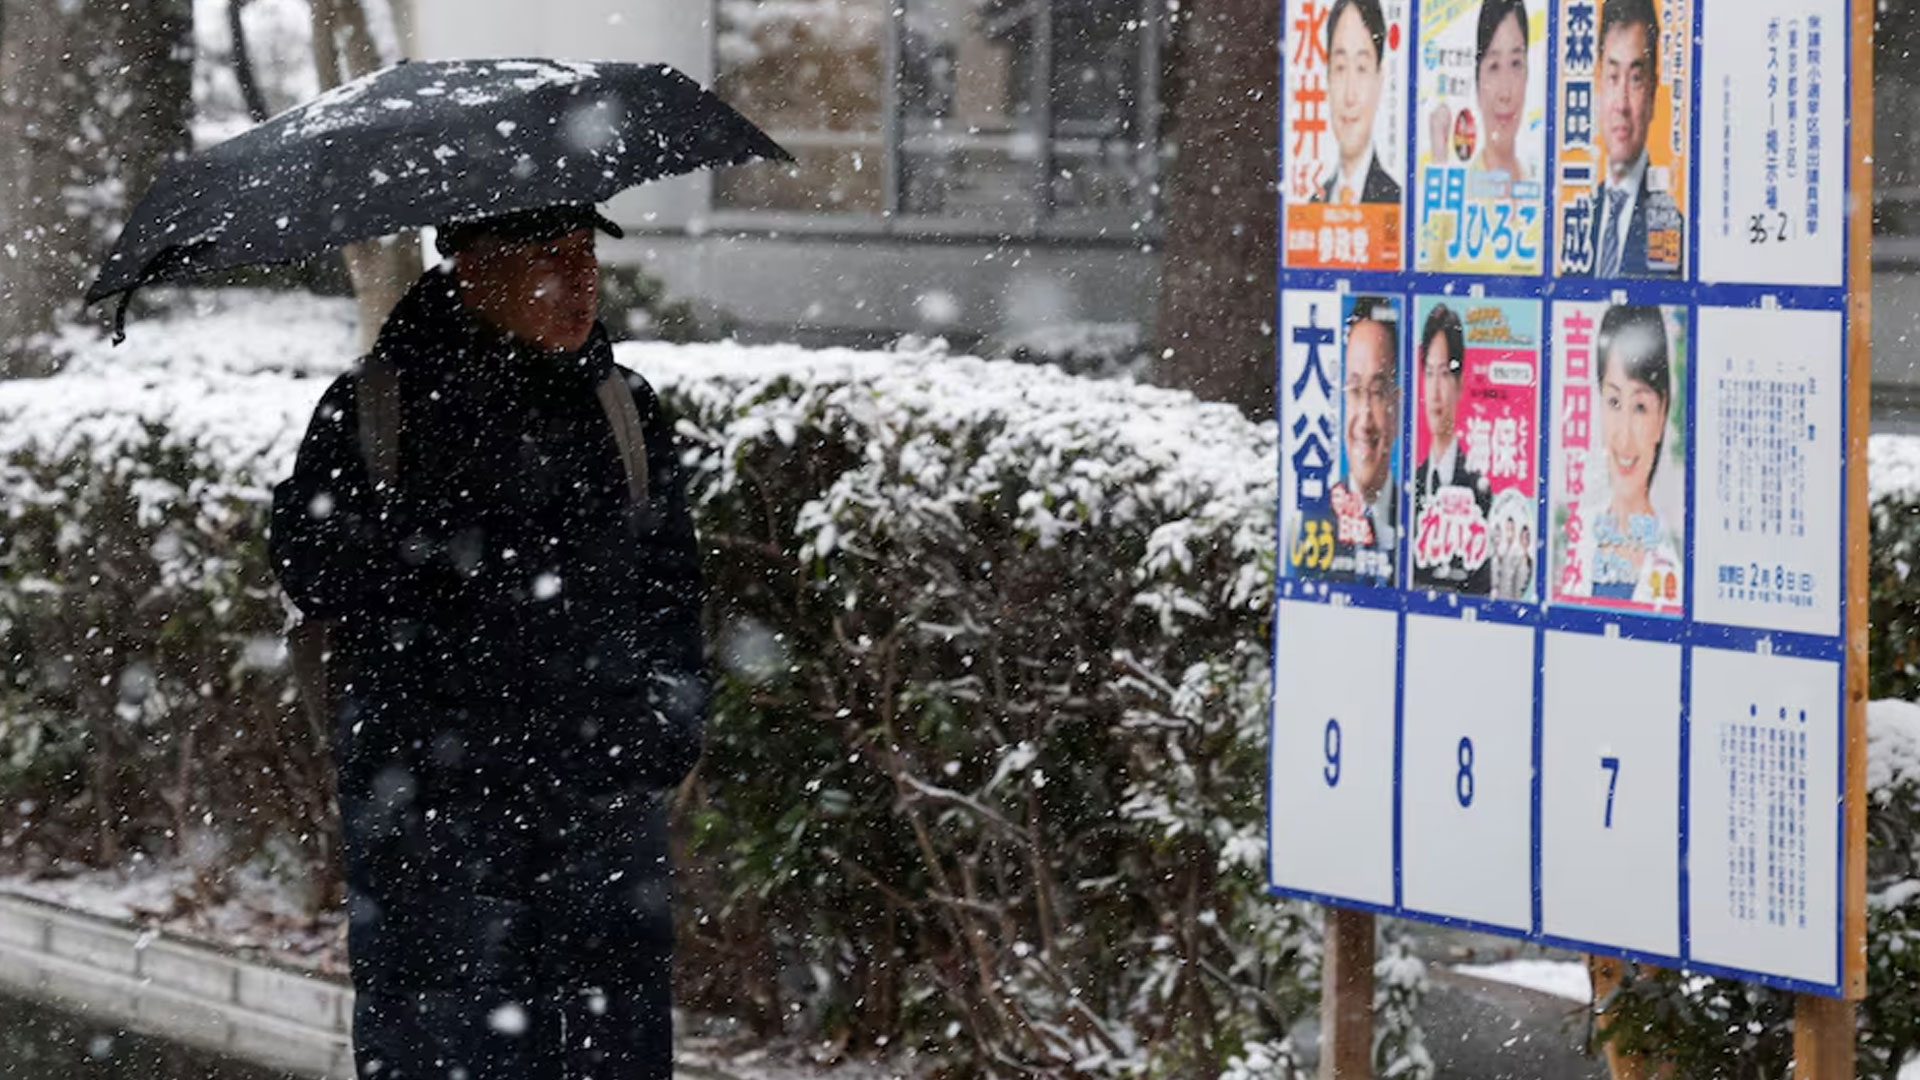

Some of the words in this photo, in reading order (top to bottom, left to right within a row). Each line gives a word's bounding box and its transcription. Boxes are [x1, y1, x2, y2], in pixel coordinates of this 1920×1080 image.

[1562, 2, 1594, 264] 森田一成
[1423, 167, 1537, 258] 門ひろこ
[1292, 304, 1334, 509] 大谷
[1562, 309, 1593, 589] 吉田はるみ
[1290, 518, 1334, 571] しろう
[1417, 506, 1487, 561] れいわ
[1323, 718, 1342, 787] 9
[1456, 736, 1475, 807] 8
[1600, 757, 1620, 828] 7
